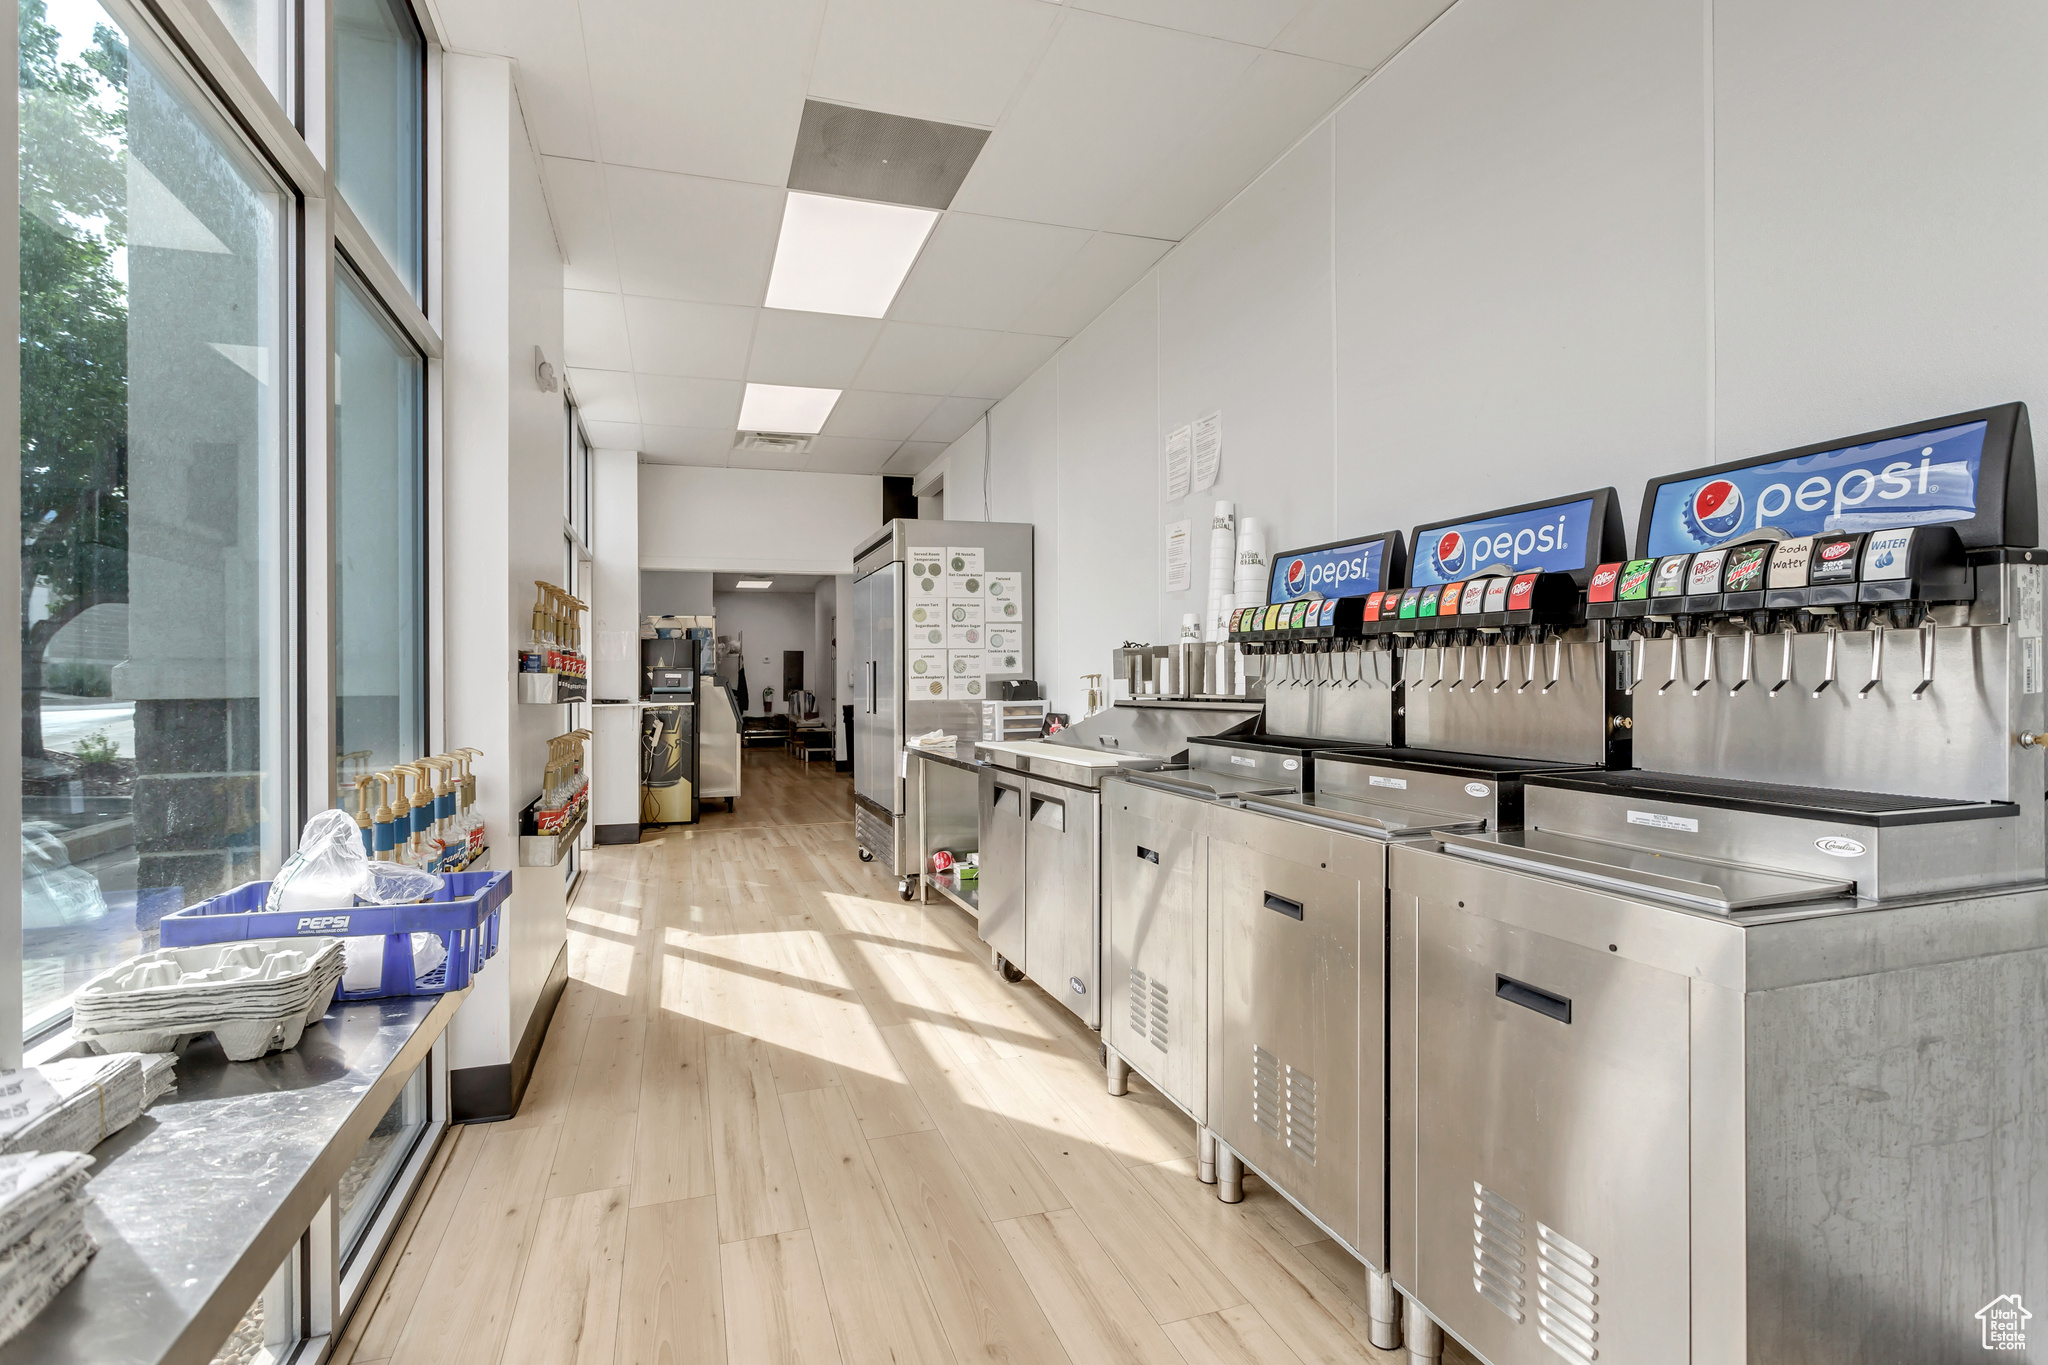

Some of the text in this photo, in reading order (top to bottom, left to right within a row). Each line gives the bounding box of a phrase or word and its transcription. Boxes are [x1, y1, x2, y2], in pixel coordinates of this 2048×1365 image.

[1755, 446, 1933, 529] pepsi
[1472, 514, 1565, 570] pepsi
[1871, 538, 1907, 550] WATER
[1309, 551, 1370, 591] pepsi
[1773, 558, 1806, 569] water
[297, 915, 351, 930] PEPSI
